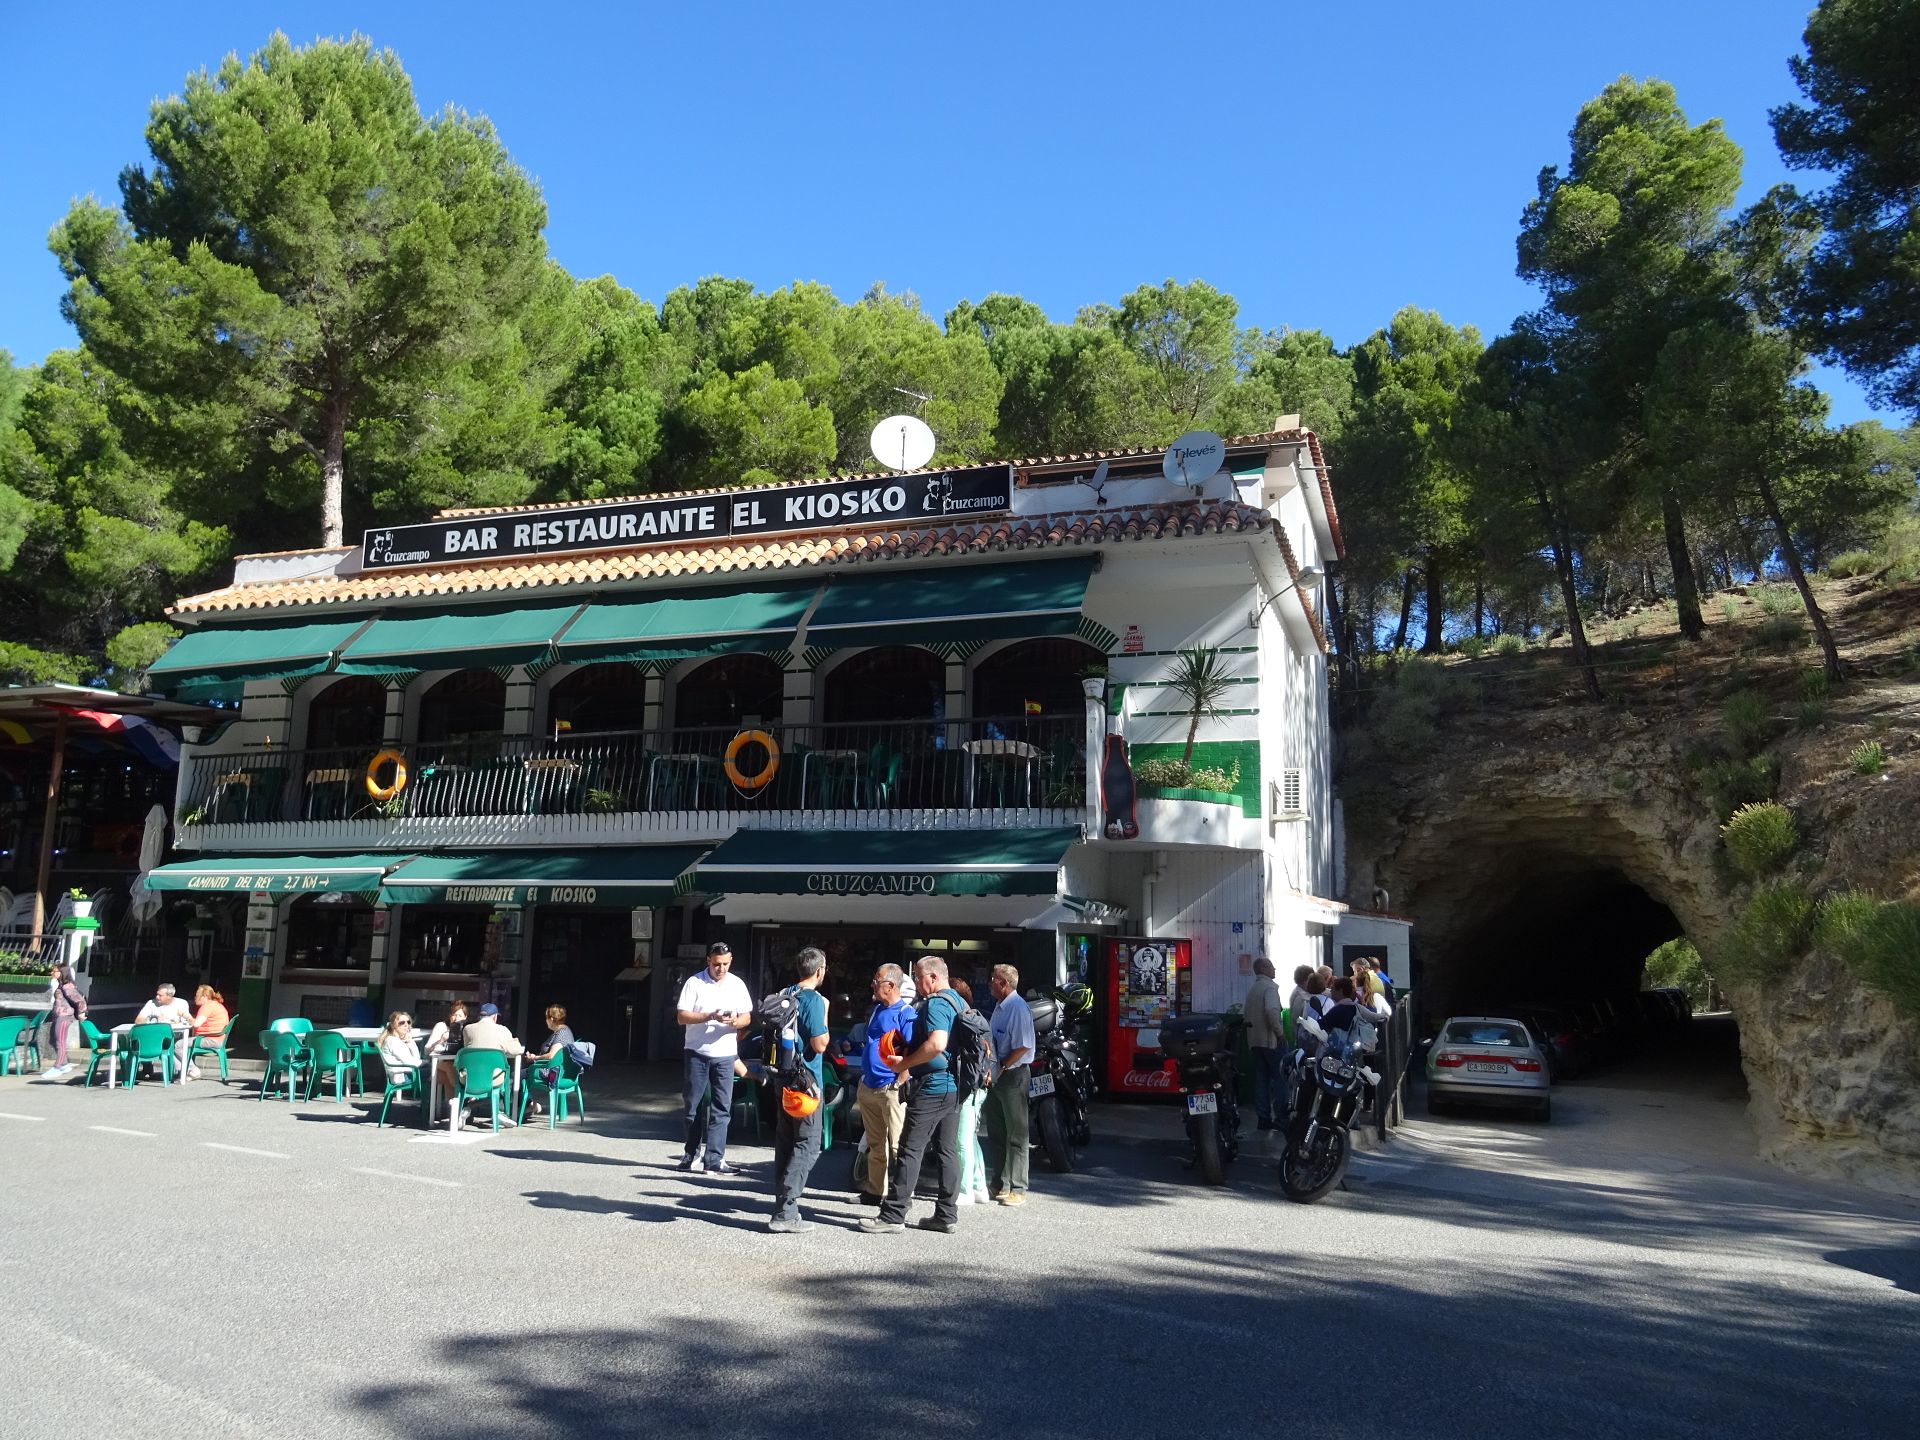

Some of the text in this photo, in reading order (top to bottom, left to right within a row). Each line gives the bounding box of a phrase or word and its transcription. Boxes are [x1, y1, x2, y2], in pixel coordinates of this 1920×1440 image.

[943, 495, 1005, 511] Cruzcampo
[445, 486, 906, 553] BAR RESTAURANTE EL KIOSKO
[384, 550, 430, 563] Cruzcampo
[187, 875, 319, 890] CAMINITO DEL REY 2,7 KM
[806, 874, 936, 893] CRUZCAMPO
[445, 886, 516, 901] RESTAURANTE
[550, 887, 597, 903] KIOSKO
[1195, 1103, 1211, 1113] KHL
